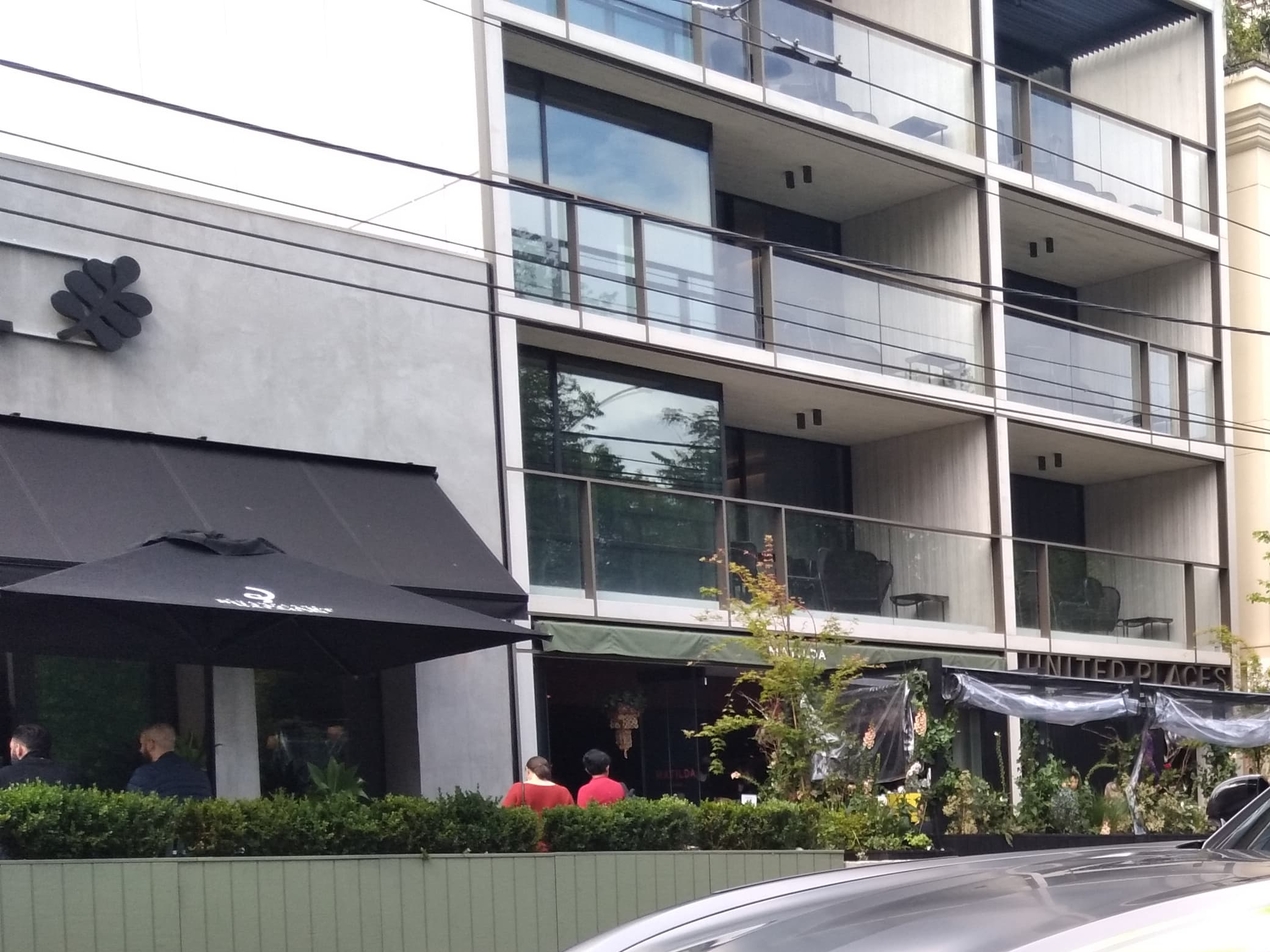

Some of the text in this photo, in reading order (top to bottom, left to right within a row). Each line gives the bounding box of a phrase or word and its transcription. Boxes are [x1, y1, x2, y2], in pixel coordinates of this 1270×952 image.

[768, 646, 827, 661] MATLDA
[1026, 653, 1228, 688] UNITED PLACES
